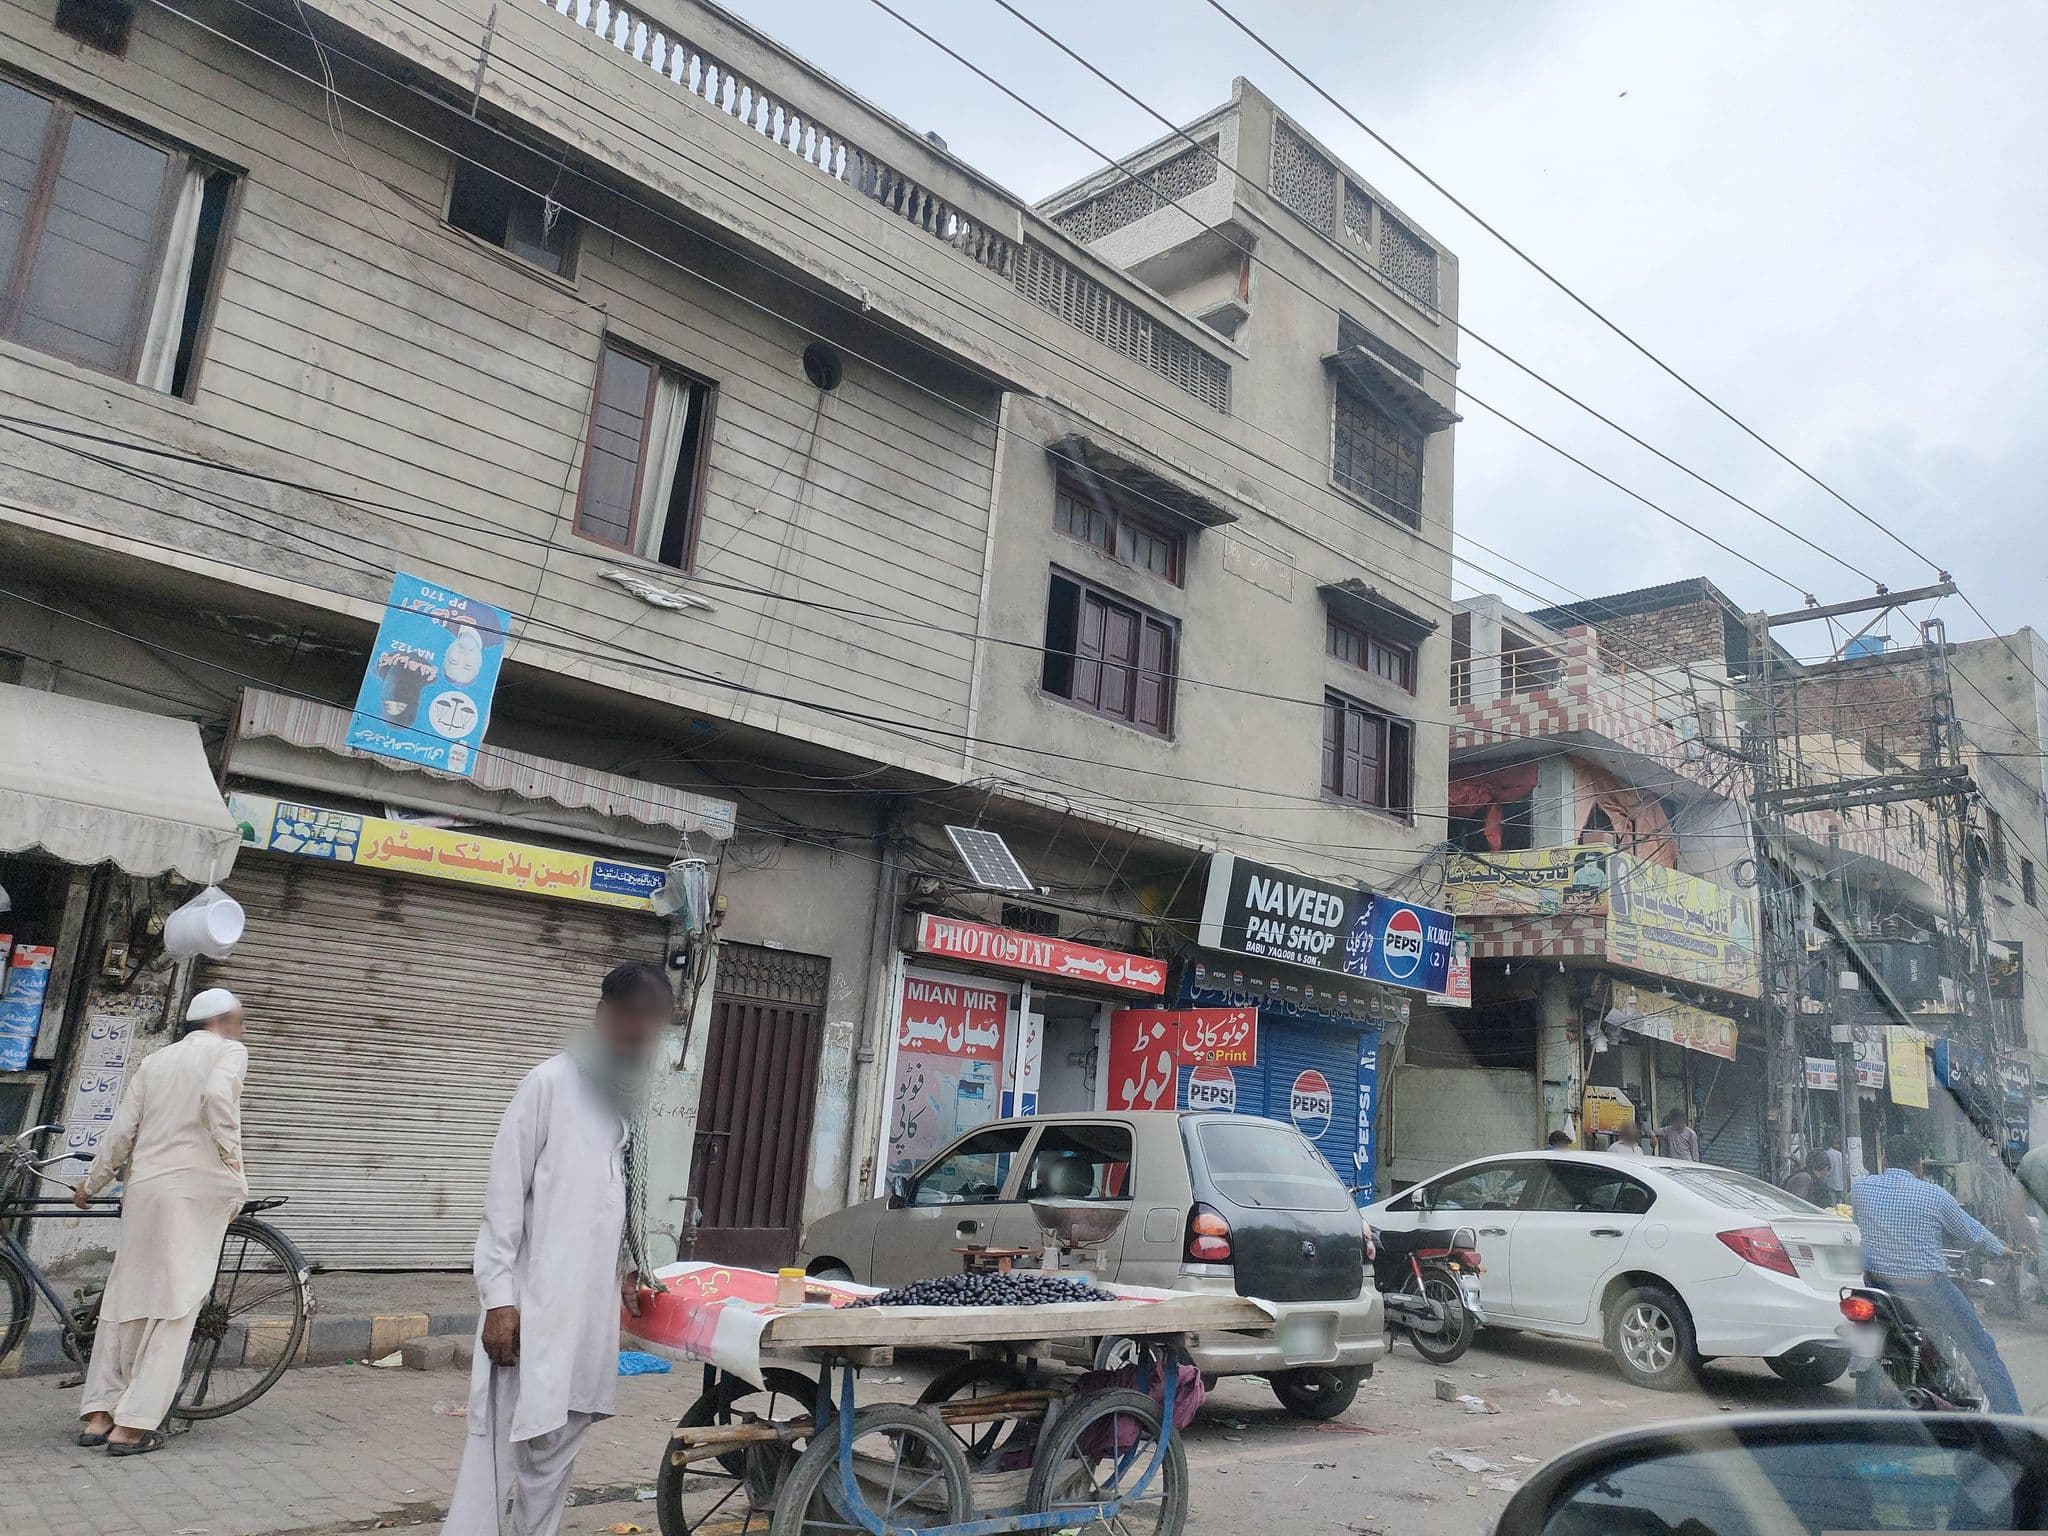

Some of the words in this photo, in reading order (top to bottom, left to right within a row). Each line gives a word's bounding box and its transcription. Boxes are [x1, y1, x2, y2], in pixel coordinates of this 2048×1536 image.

[363, 829, 434, 862] سٹور
[438, 843, 531, 889] پلاسٹک
[534, 863, 589, 889] امین
[1245, 875, 1344, 928] NAVEED
[933, 923, 1055, 968] PHOTOSTAT
[1245, 941, 1265, 954] BABU
[1268, 946, 1295, 961] YAQOOB
[1246, 916, 1285, 948] PAN
[1288, 925, 1336, 955] SHOP
[1386, 932, 1421, 954] PEPSI
[1427, 926, 1451, 946] KUKU
[1056, 952, 1108, 975] میر
[1106, 958, 1162, 986] میاں
[1429, 951, 1445, 968] (2)
[907, 982, 957, 1006] MIAN
[963, 991, 997, 1012] MIR
[900, 1013, 948, 1048] میر
[947, 1010, 1000, 1053] میاں
[1182, 1018, 1227, 1060] کاپی
[1217, 1013, 1249, 1047] فوٹو
[1216, 1050, 1247, 1061] Print
[895, 1061, 925, 1101] فوٹو
[1191, 1084, 1234, 1104] PEPSI
[1292, 1095, 1330, 1115] PEPSI
[1358, 1085, 1371, 1163] PEPSI
